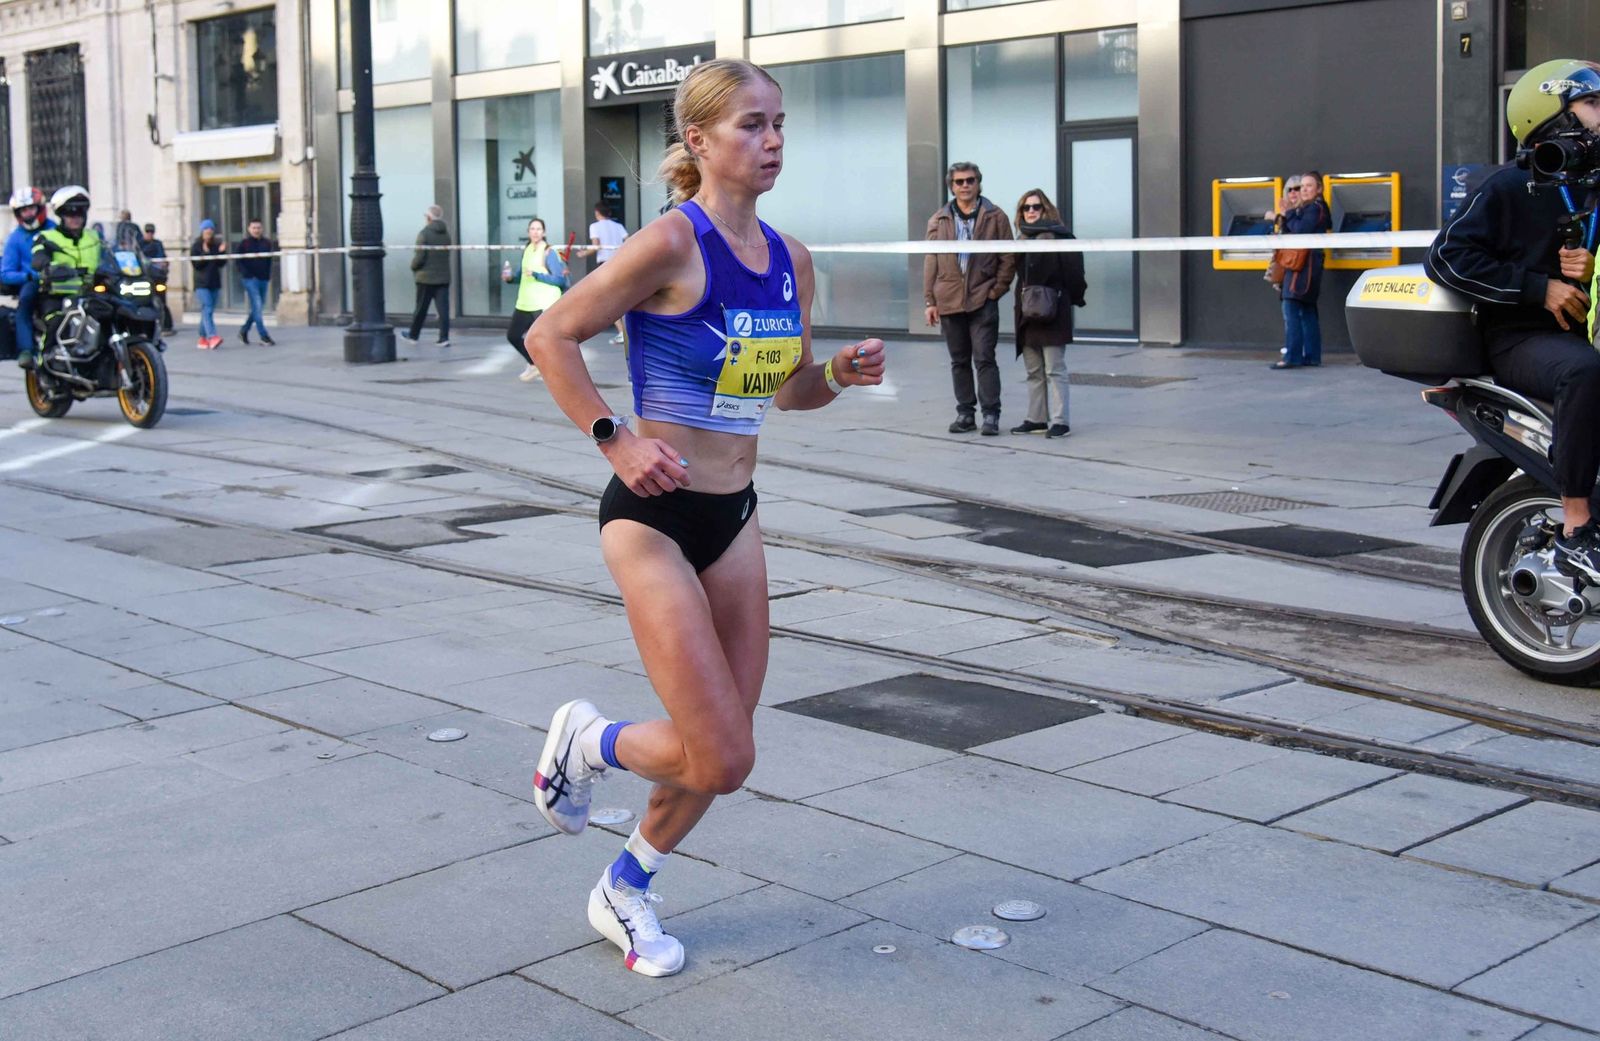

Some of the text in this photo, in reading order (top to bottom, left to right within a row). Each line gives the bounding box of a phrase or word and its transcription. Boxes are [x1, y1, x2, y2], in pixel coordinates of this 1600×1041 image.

[1461, 37, 1471, 52] 7
[1363, 282, 1416, 294] MOTO ENLACE
[754, 318, 794, 332] ZURICH
[756, 350, 781, 364] F-103
